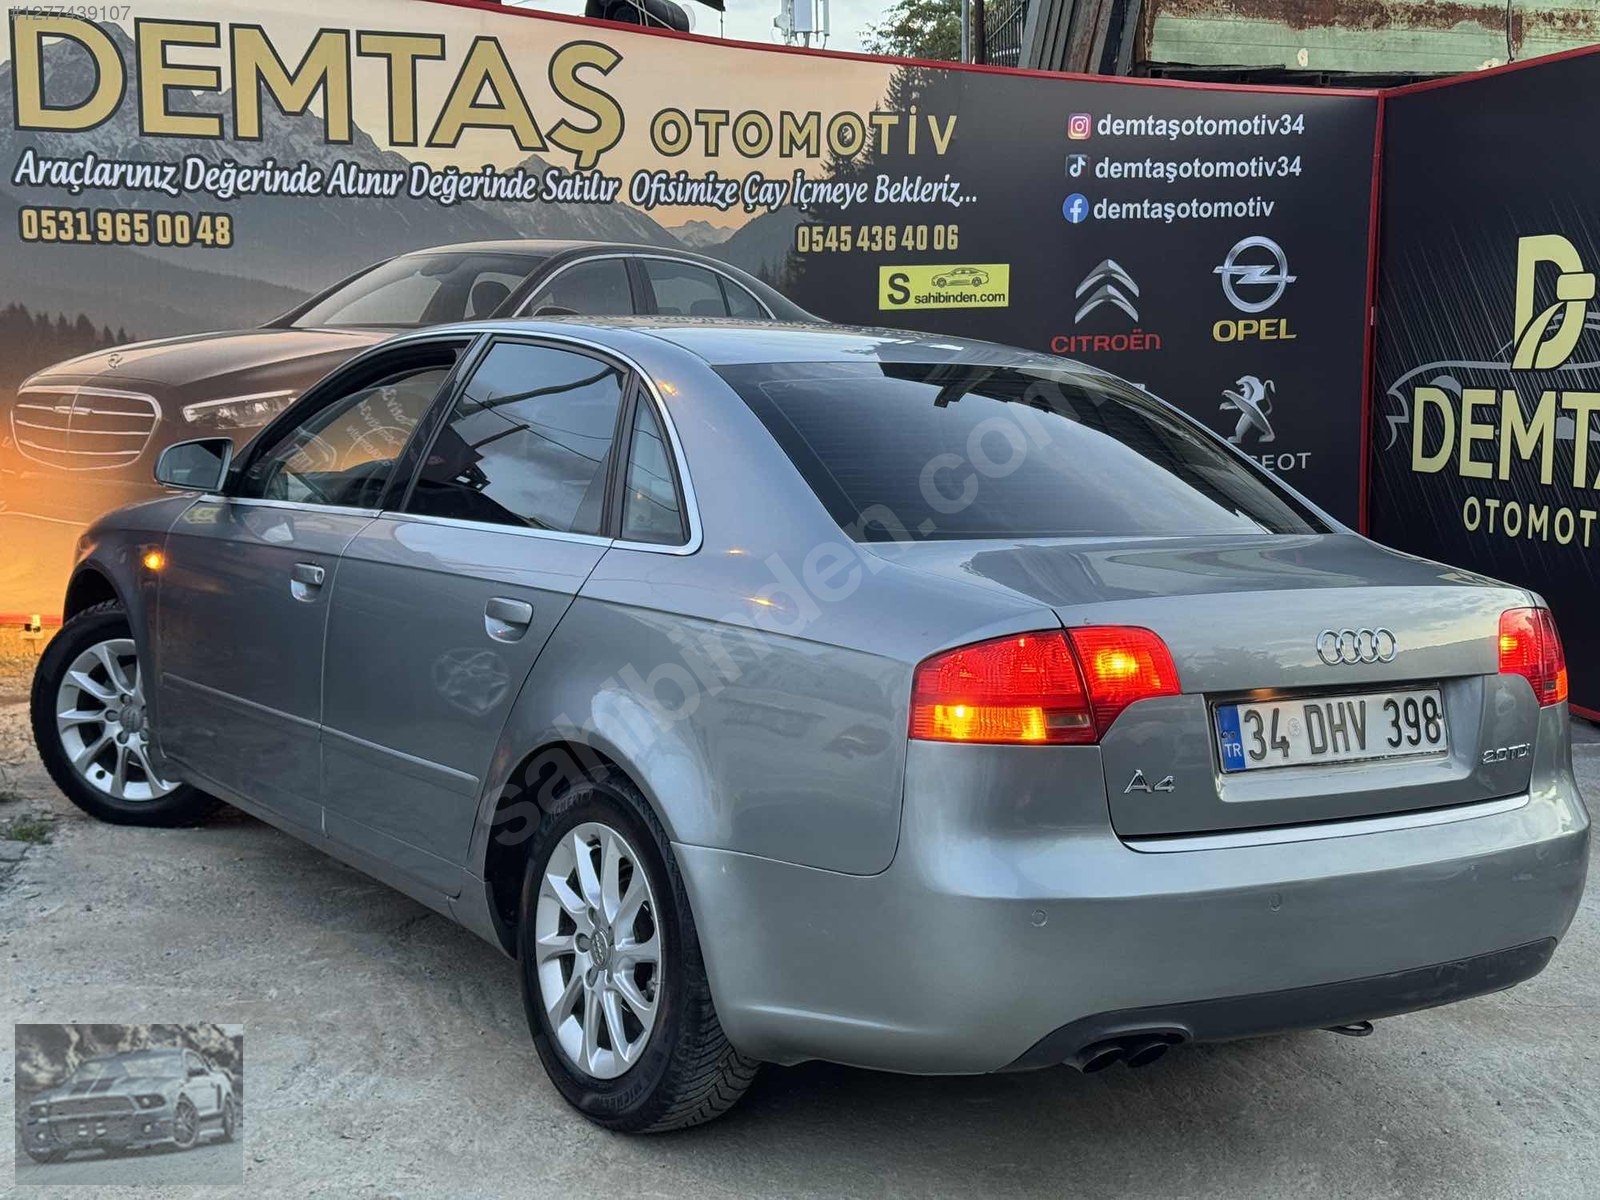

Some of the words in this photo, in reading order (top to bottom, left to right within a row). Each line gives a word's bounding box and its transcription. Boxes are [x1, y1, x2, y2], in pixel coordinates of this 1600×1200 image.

[9, 9, 626, 170] DEMTAŞ
[650, 104, 958, 159] OTOMOTİV
[1097, 112, 1305, 141] demtaşotomotiv34
[14, 149, 179, 194] Araçlarınız
[184, 156, 322, 199] Değerinde
[327, 162, 403, 196] Alınır
[409, 164, 538, 204] Değerinde
[541, 172, 620, 202] Satılır
[631, 172, 738, 209] Ofisimize
[743, 174, 789, 210] Çay
[792, 170, 869, 210] İçmeye
[1095, 155, 1302, 184] demtaşotomotiv34
[1093, 196, 1275, 224] demtaşotomotiv
[796, 224, 852, 253] 0545
[856, 225, 897, 252] 436
[900, 225, 928, 251] 40
[932, 224, 960, 251] 06
[887, 272, 911, 305] S
[914, 291, 1006, 305] sahibinden.com
[1211, 318, 1298, 343] OPEL
[1411, 386, 1600, 492] DEMT
[1244, 708, 1290, 762] 34
[1304, 700, 1367, 756] DHV
[1384, 696, 1440, 748] 398
[1224, 742, 1243, 760] TR
[1123, 769, 1176, 794] A4
